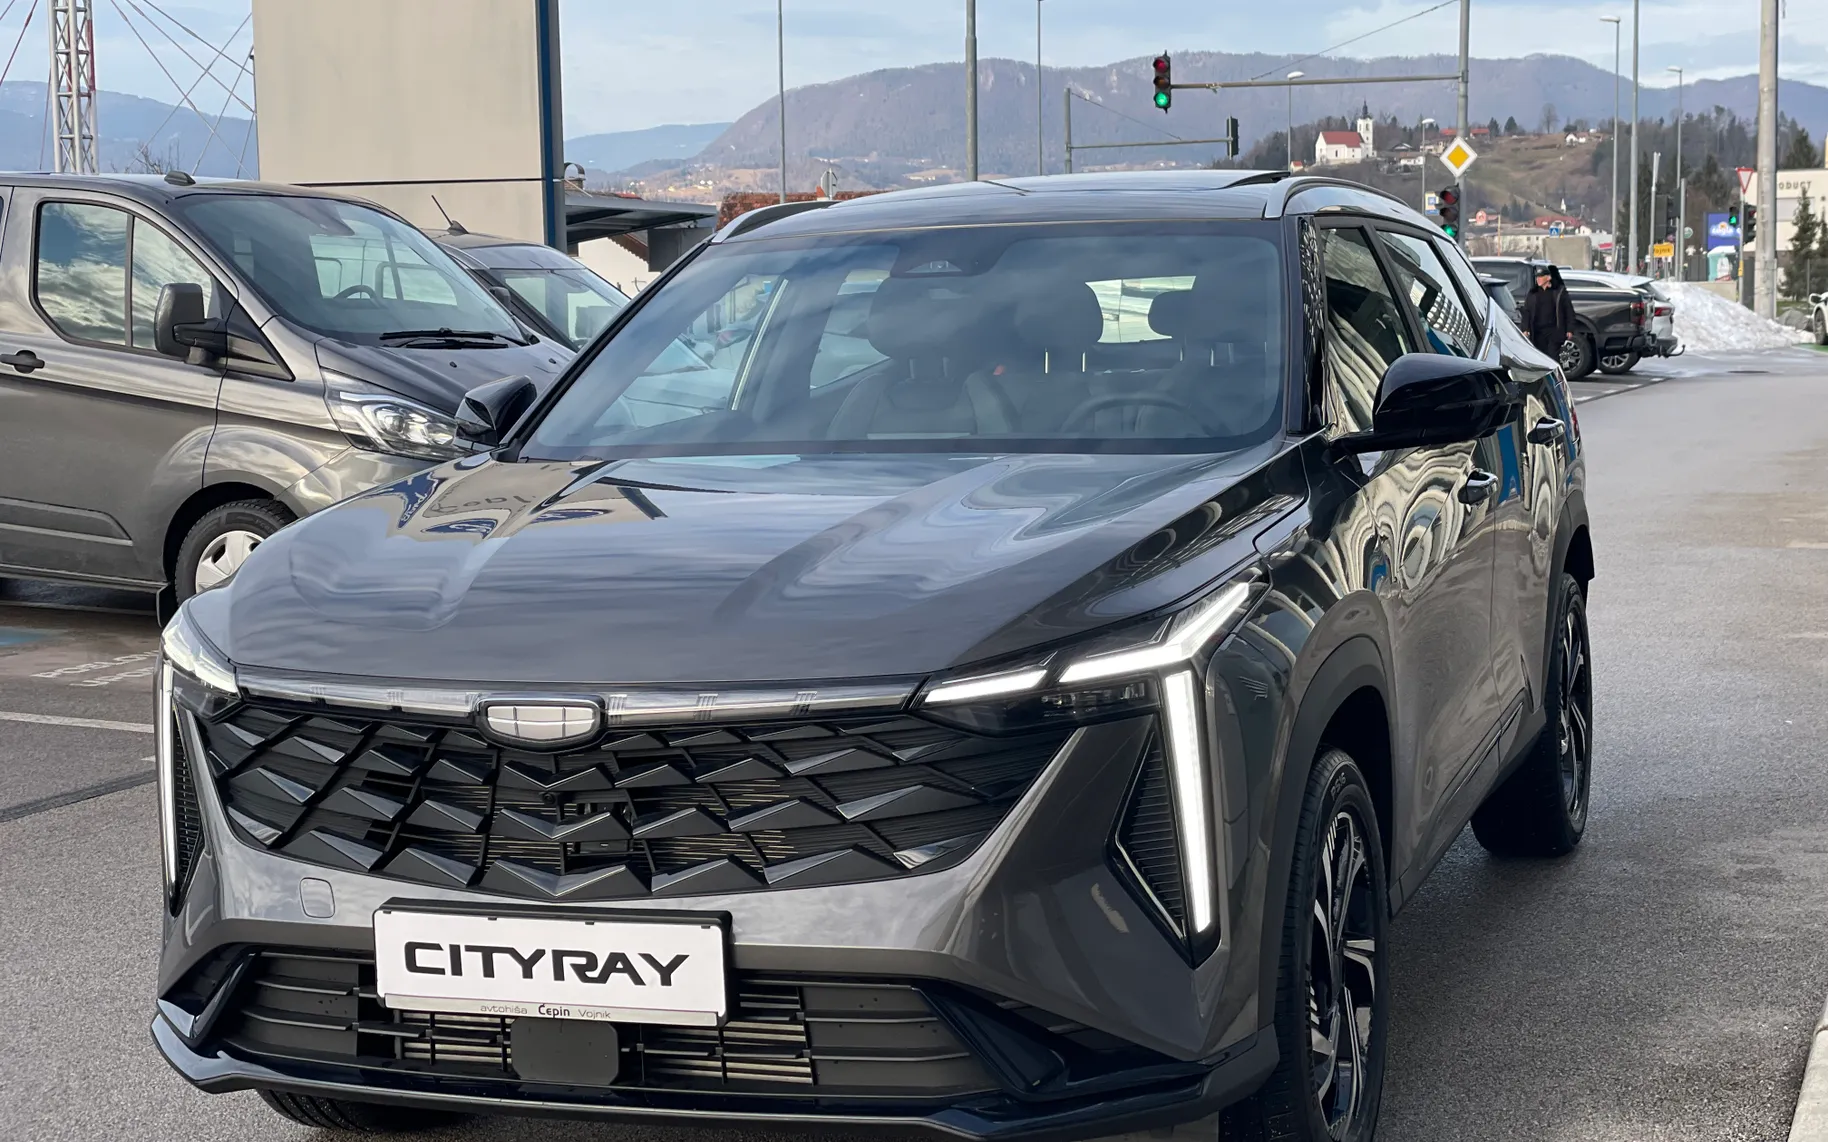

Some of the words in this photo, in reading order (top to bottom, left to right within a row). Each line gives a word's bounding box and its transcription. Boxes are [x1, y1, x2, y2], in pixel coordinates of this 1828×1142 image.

[1778, 181, 1812, 190] ODUCT
[404, 941, 690, 987] CITYRAY
[578, 1009, 611, 1019] Vojnik
